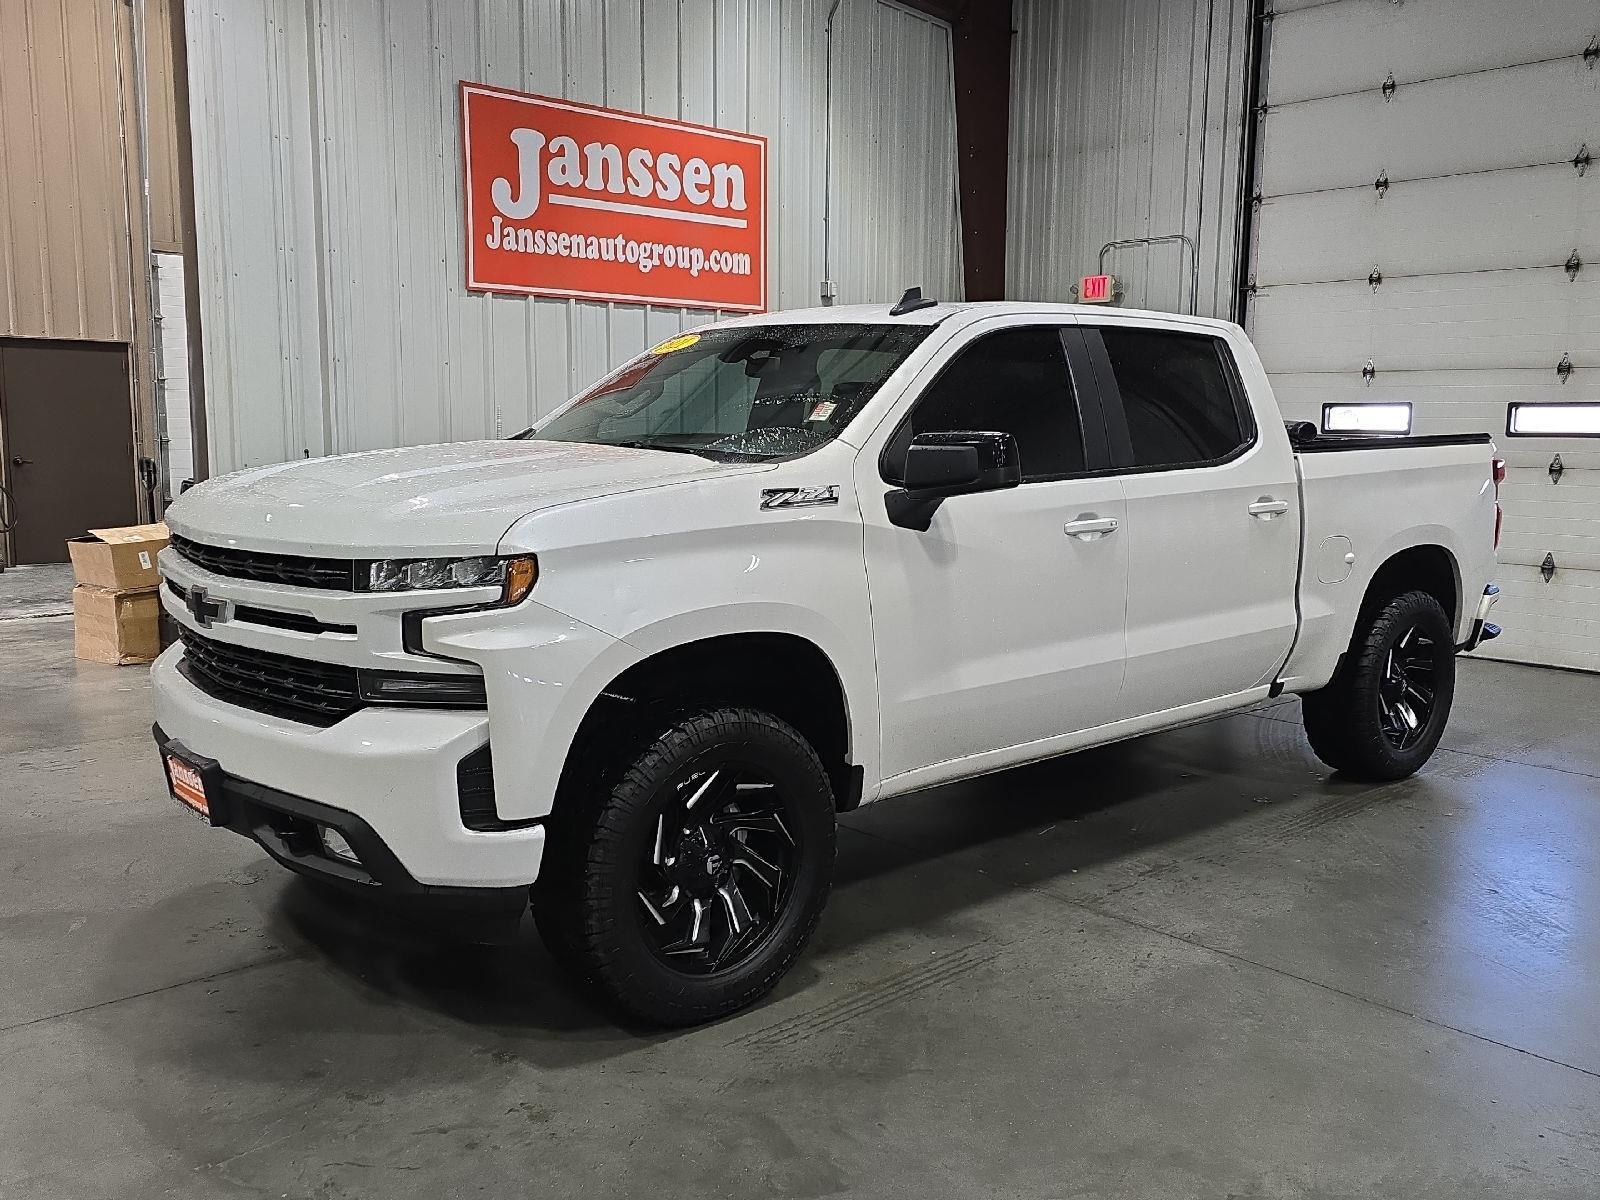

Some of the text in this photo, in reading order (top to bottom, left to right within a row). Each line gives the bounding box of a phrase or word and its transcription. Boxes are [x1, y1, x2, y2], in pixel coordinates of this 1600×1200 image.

[491, 127, 748, 220] Janssen
[485, 216, 751, 277] Janssenautogroup.com
[1084, 276, 1107, 298] EXIT
[760, 485, 840, 510] Z71
